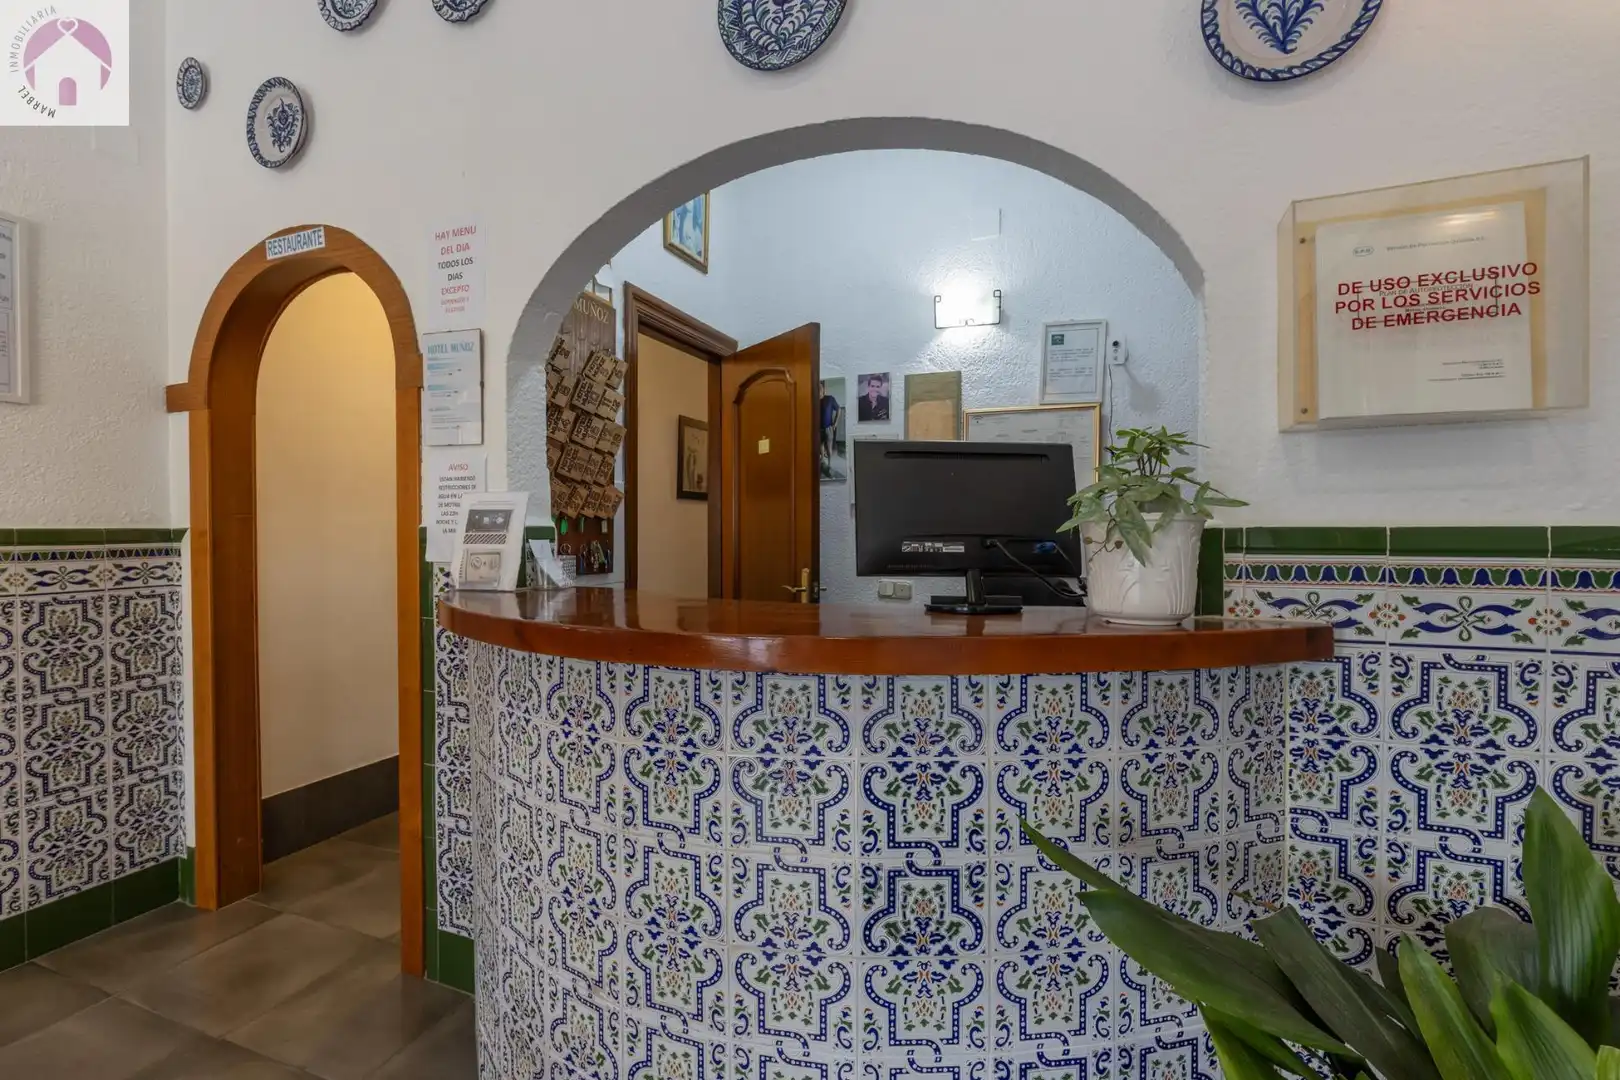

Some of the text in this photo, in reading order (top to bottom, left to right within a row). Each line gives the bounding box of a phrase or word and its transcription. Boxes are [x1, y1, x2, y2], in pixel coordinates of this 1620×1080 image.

[435, 225, 477, 241] HAY MENU
[267, 229, 323, 257] RESTAURANTE
[441, 243, 470, 256] DEL DIA
[437, 257, 474, 269] TODOS LOS
[447, 272, 463, 282] DIAS
[1338, 262, 1538, 296] DE USO EXCLUSIVO
[441, 284, 470, 296] EXCEPTO
[1335, 298, 1375, 314] POR
[1382, 293, 1421, 310] LOS
[1428, 281, 1541, 304] SERVICIOS
[573, 298, 609, 324] MUÑOZ
[1352, 302, 1522, 331] DE EMERGENCIA
[448, 463, 469, 472] AVISO
